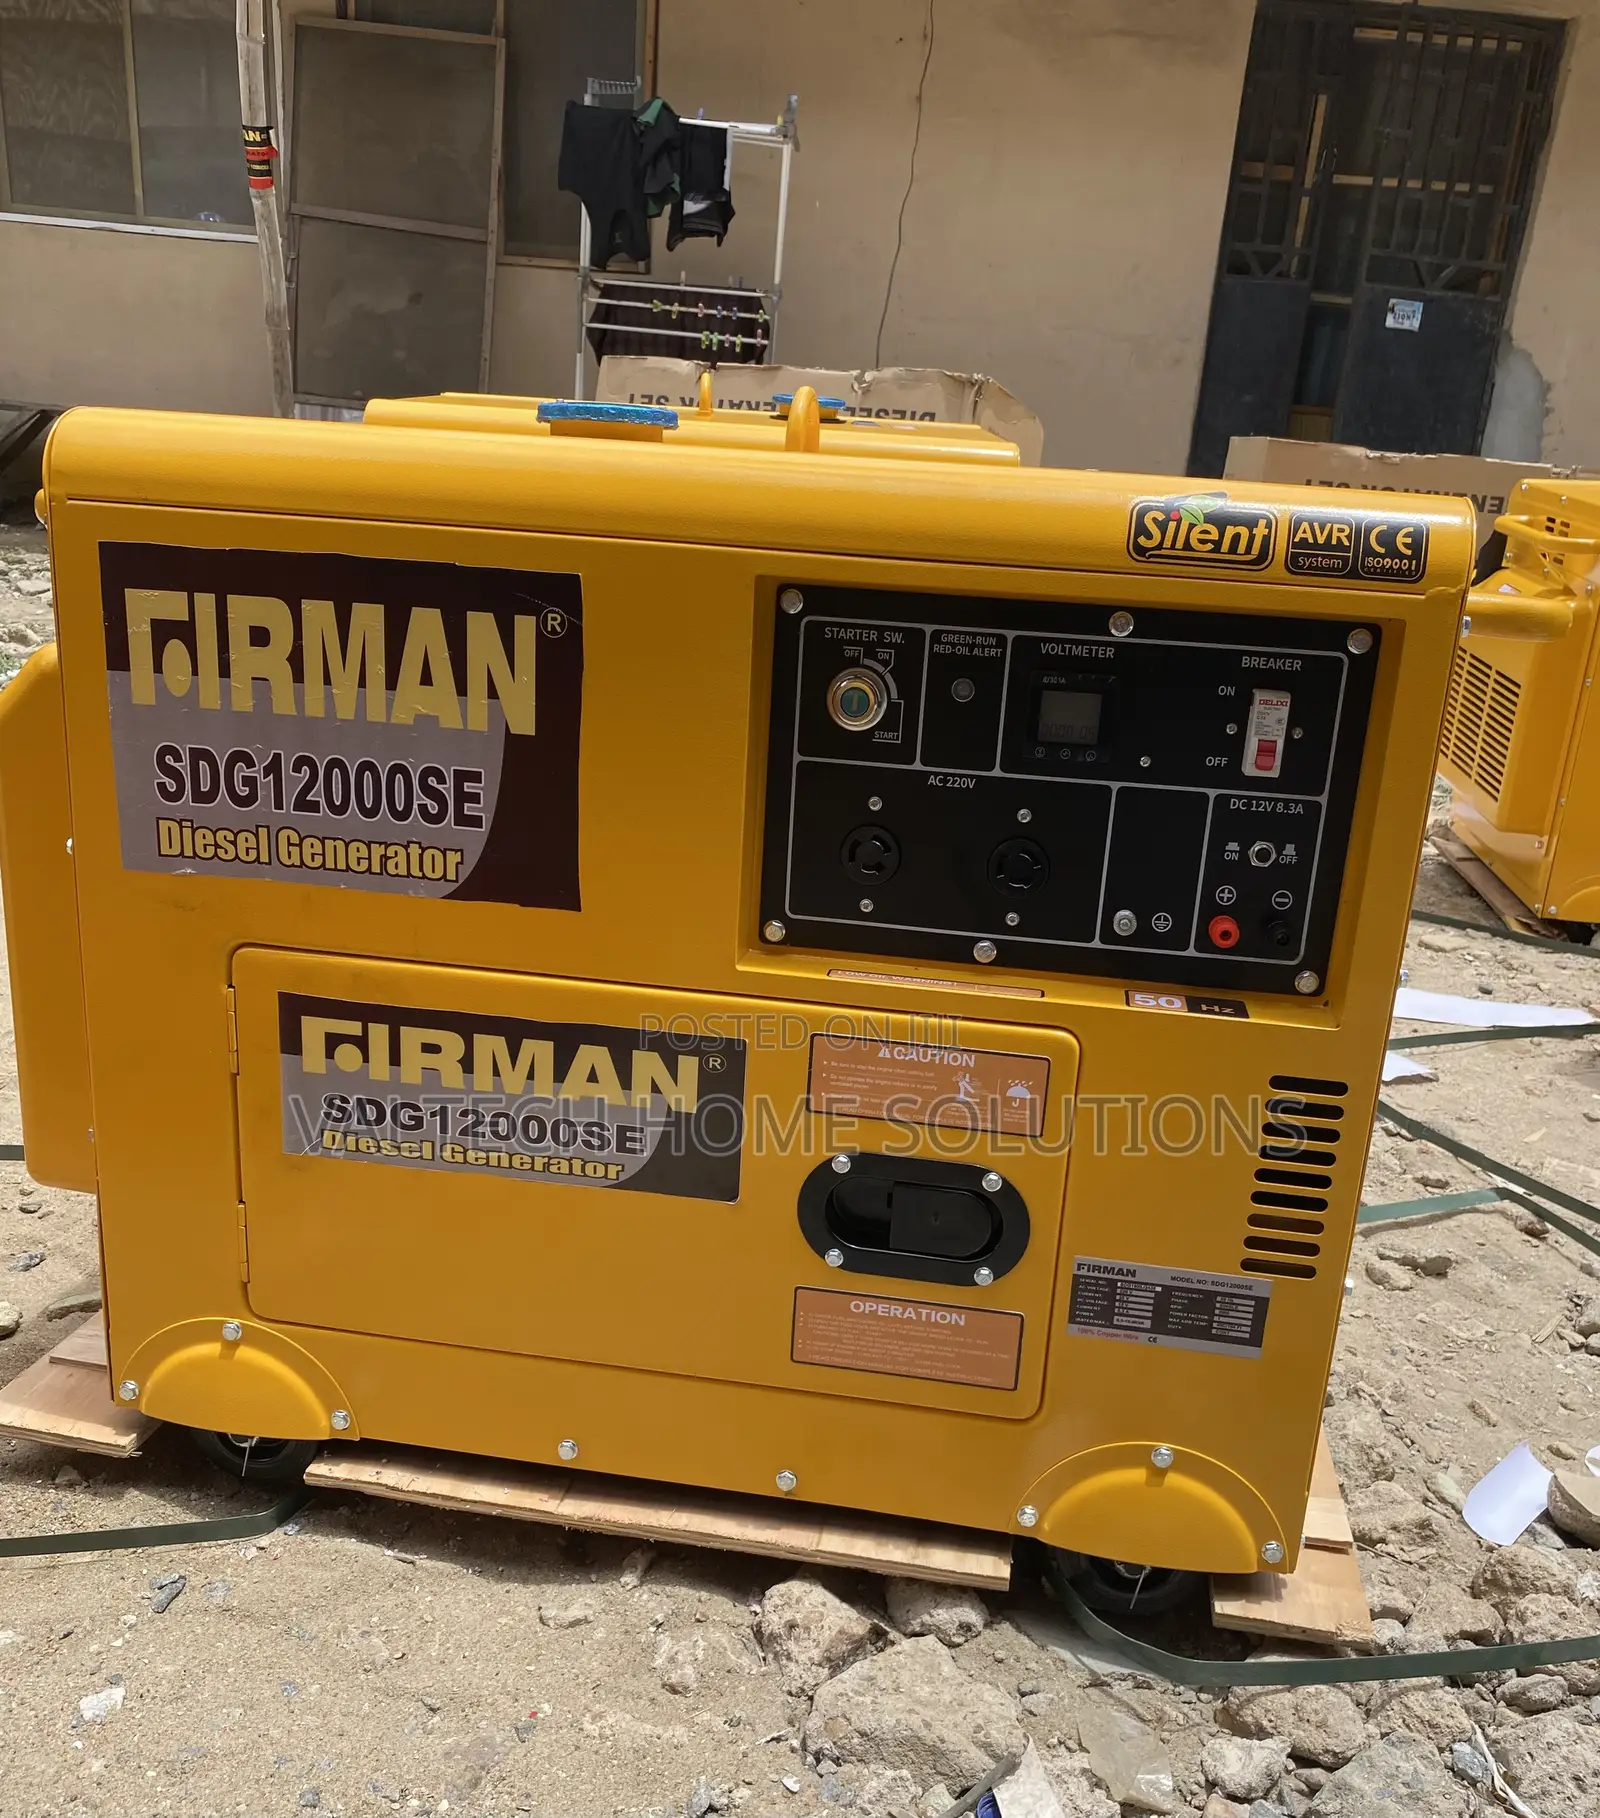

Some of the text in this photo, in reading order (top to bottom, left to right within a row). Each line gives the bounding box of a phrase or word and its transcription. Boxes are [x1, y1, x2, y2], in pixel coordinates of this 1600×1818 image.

[1136, 509, 1269, 555] Silent
[1293, 521, 1351, 547] AVR
[1369, 525, 1414, 556] CE
[1298, 556, 1342, 570] system
[1364, 557, 1416, 571] ISO9001
[824, 627, 905, 644] STARTER SW.
[940, 633, 996, 646] GREEN-RUN
[844, 650, 860, 658] OFF
[877, 652, 890, 660] ON
[933, 644, 1002, 658] RED-OIL ALERT
[1040, 642, 1115, 659] VOLTMETER
[124, 588, 536, 736] FIRMAN
[1241, 656, 1302, 672] BREAKER
[1217, 685, 1236, 696] ON
[1258, 699, 1288, 707] DELIXI
[874, 731, 898, 740] START
[1205, 756, 1228, 767] OFF
[154, 742, 486, 832] SDG12000SE
[927, 774, 976, 789] AC 220V
[1229, 798, 1304, 815] DC 12V 8.3A
[156, 816, 464, 884] Diesel Generator
[1224, 851, 1240, 861] ON
[1279, 855, 1298, 865] OFF
[1133, 993, 1235, 1015] 50 Hz
[301, 1015, 699, 1114] FIRMAN
[893, 1046, 976, 1068] CAUTION
[321, 1092, 646, 1158] SDG12000SE
[321, 1128, 625, 1183] Diesel Generator
[1076, 1262, 1136, 1278] FIRMAN
[1170, 1275, 1195, 1284] MODEL
[1210, 1280, 1253, 1291] SDG12000SE
[849, 1301, 966, 1327] OPERATION
